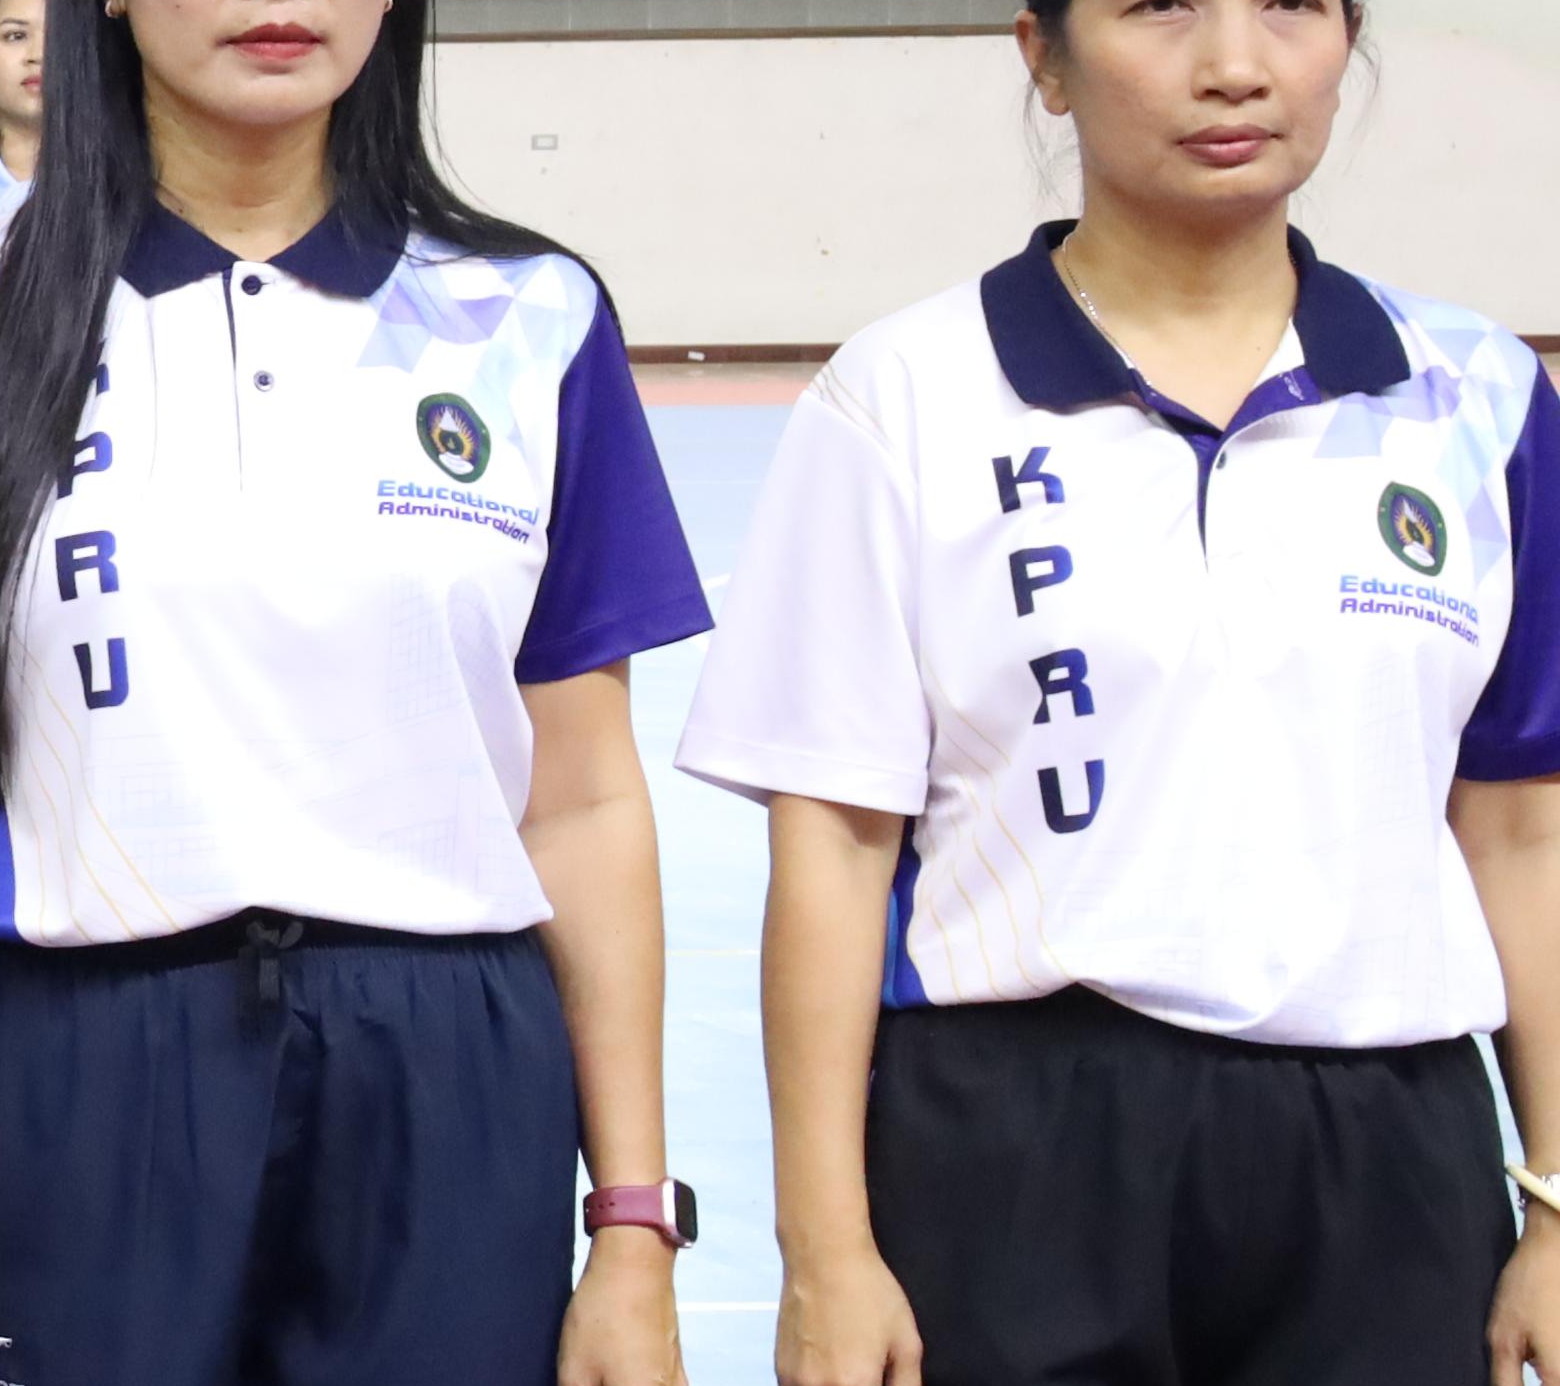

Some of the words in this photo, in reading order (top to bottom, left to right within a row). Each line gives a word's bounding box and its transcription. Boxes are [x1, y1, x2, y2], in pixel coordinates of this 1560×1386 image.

[376, 479, 540, 525] Educational
[377, 500, 529, 544] Administration
[991, 446, 1106, 835] KPRU
[1340, 598, 1479, 646] Administration
